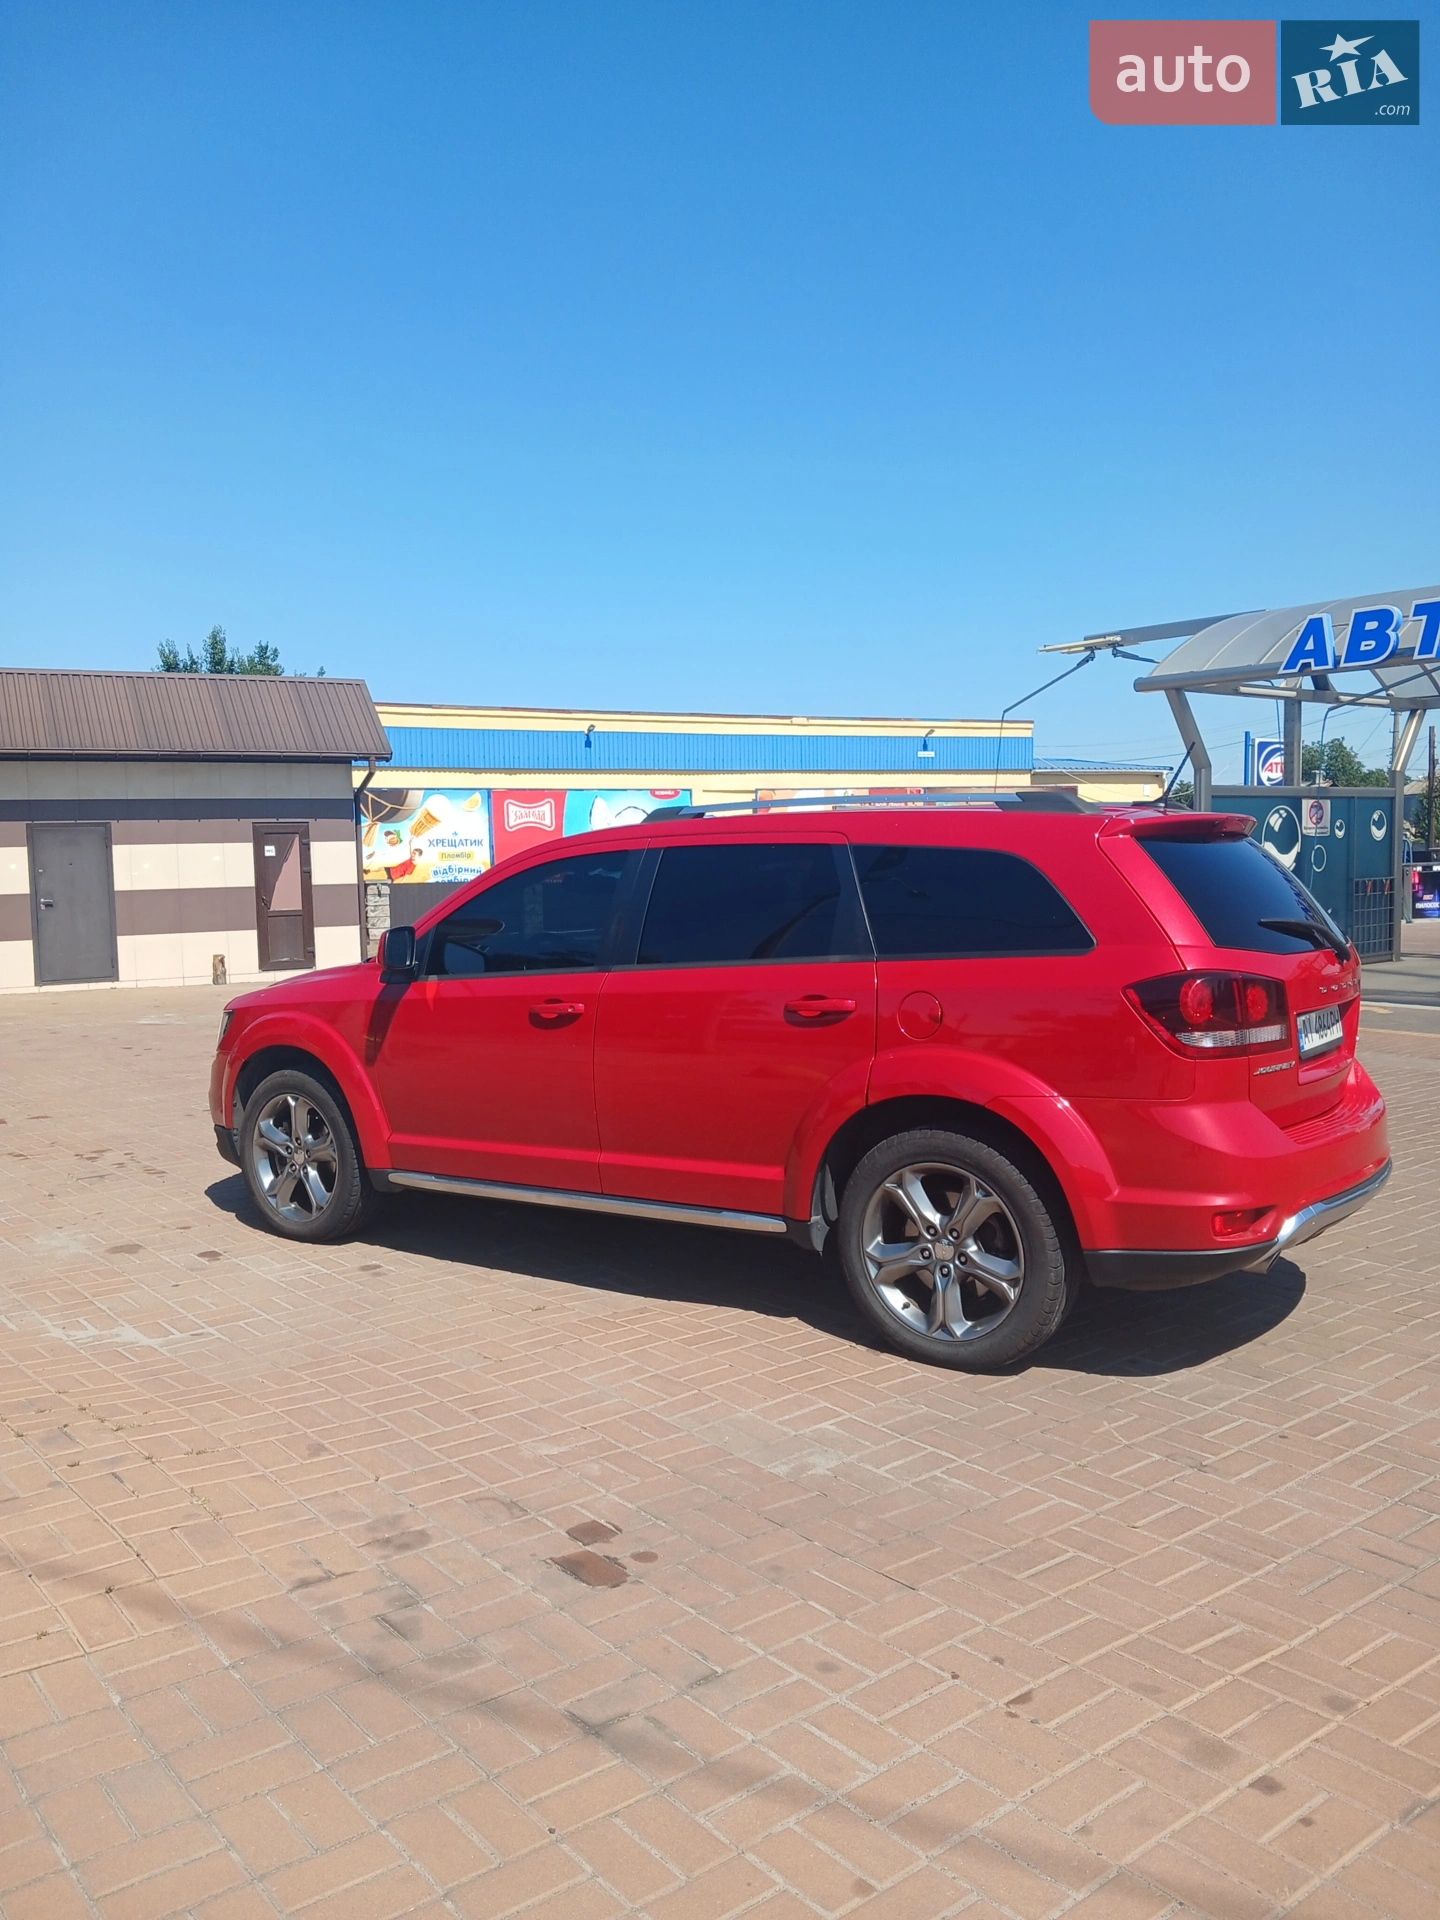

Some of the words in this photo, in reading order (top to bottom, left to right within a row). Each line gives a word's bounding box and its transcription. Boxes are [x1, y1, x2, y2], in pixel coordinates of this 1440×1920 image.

[427, 838, 484, 849] ХРЕЩАТИК
[441, 851, 472, 860] Пломбір
[433, 863, 482, 877] відбірний
[1253, 1060, 1296, 1076] JOURNEY
